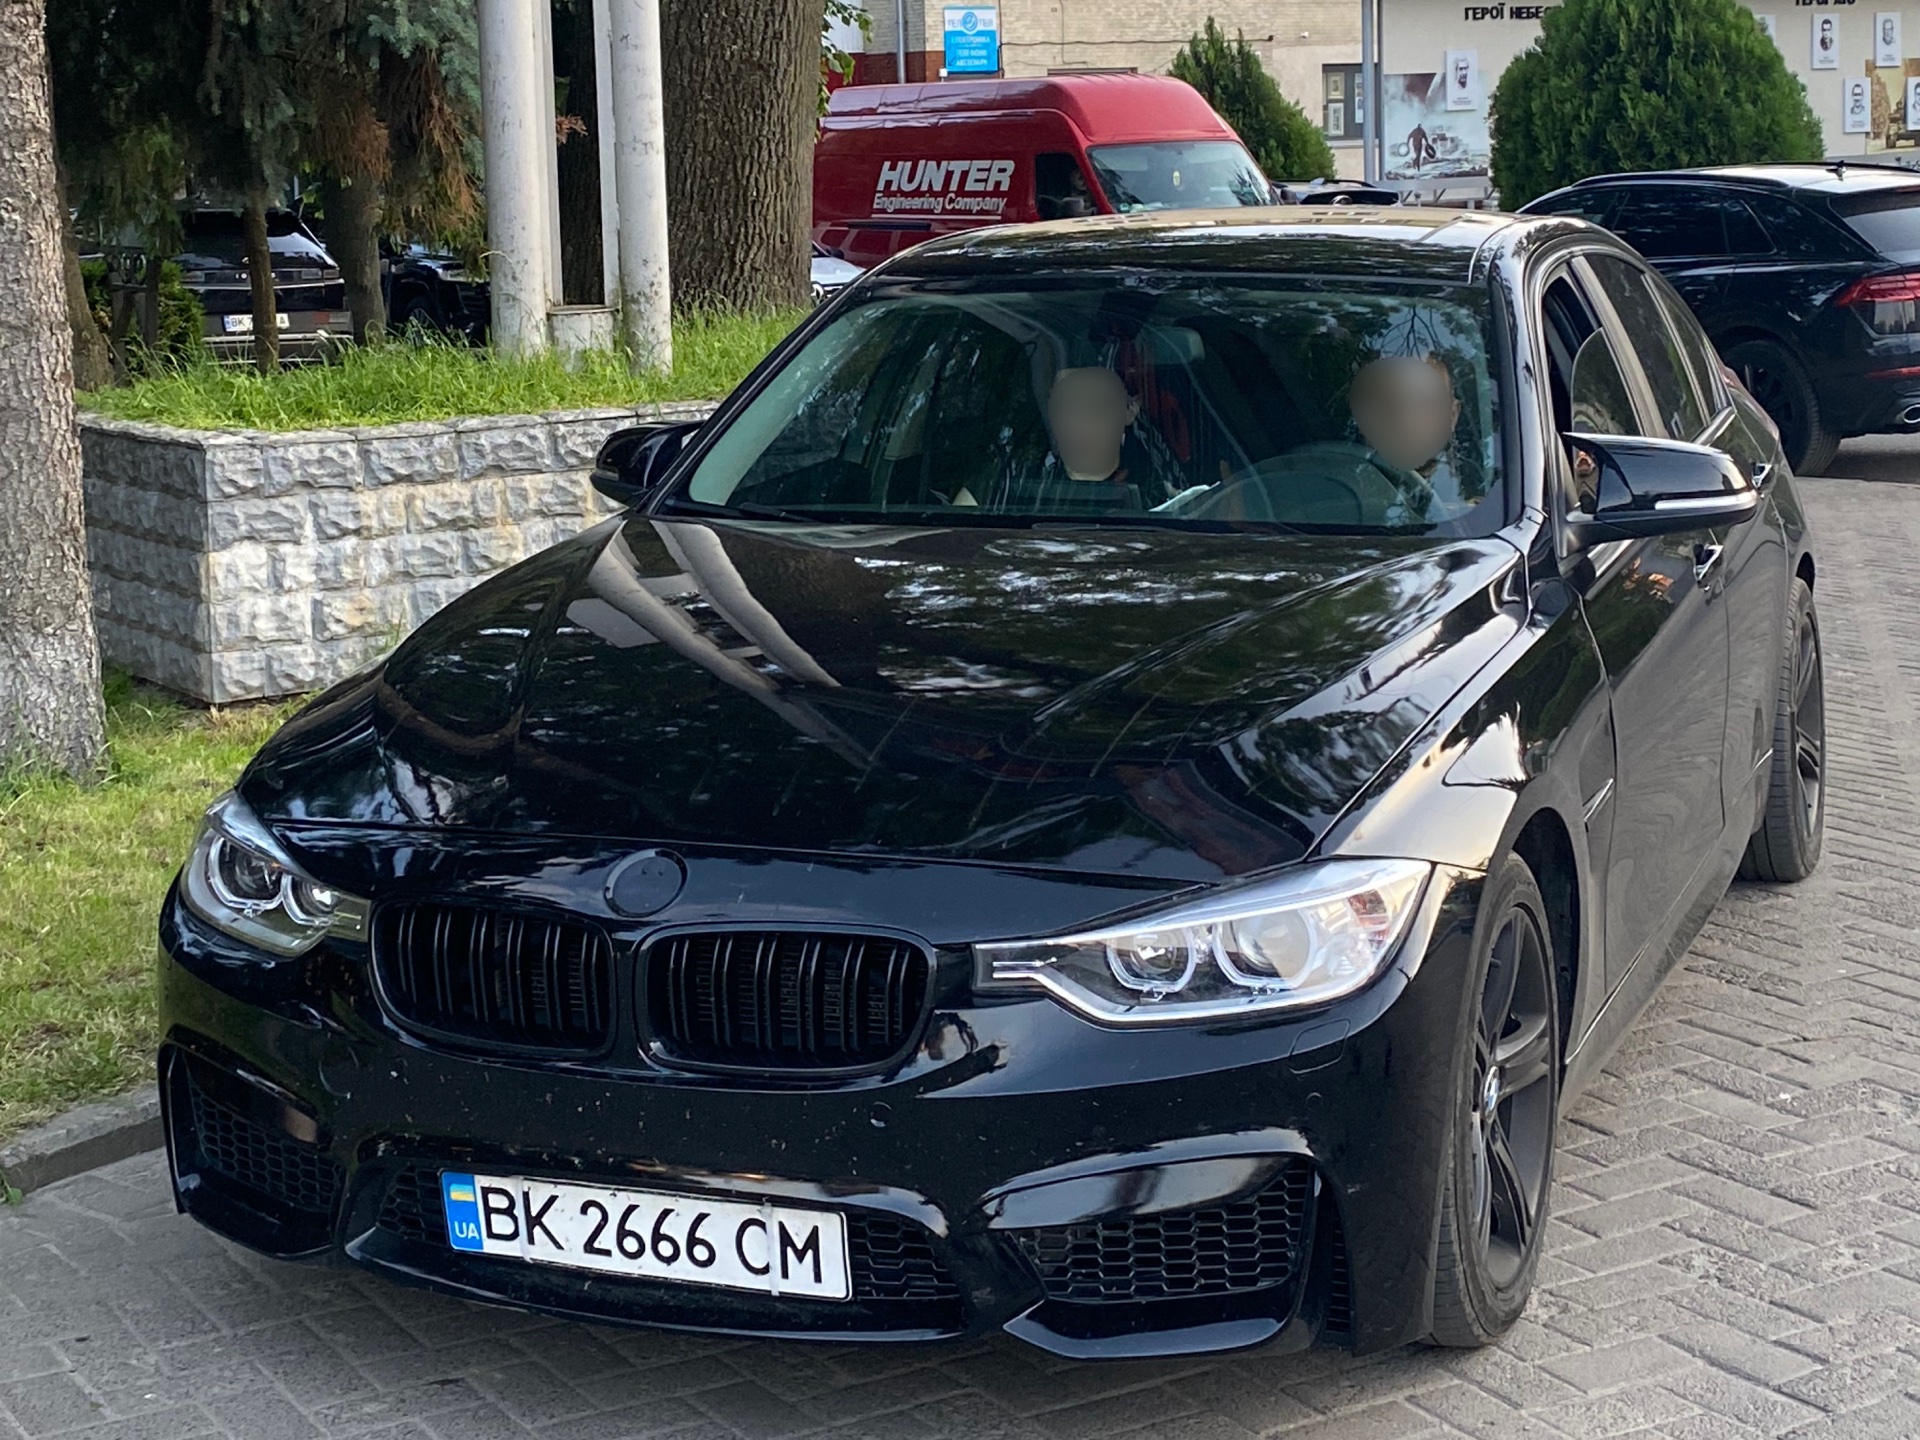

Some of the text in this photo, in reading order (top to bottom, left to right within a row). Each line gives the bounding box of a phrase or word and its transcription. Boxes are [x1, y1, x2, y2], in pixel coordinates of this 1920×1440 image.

[1464, 3, 1505, 21] ГЕРОЇ
[876, 159, 1015, 192] HUNTER
[873, 192, 1008, 214] Engineering Company
[454, 1221, 480, 1240] UA
[480, 1186, 822, 1284] BK 2666 CM
